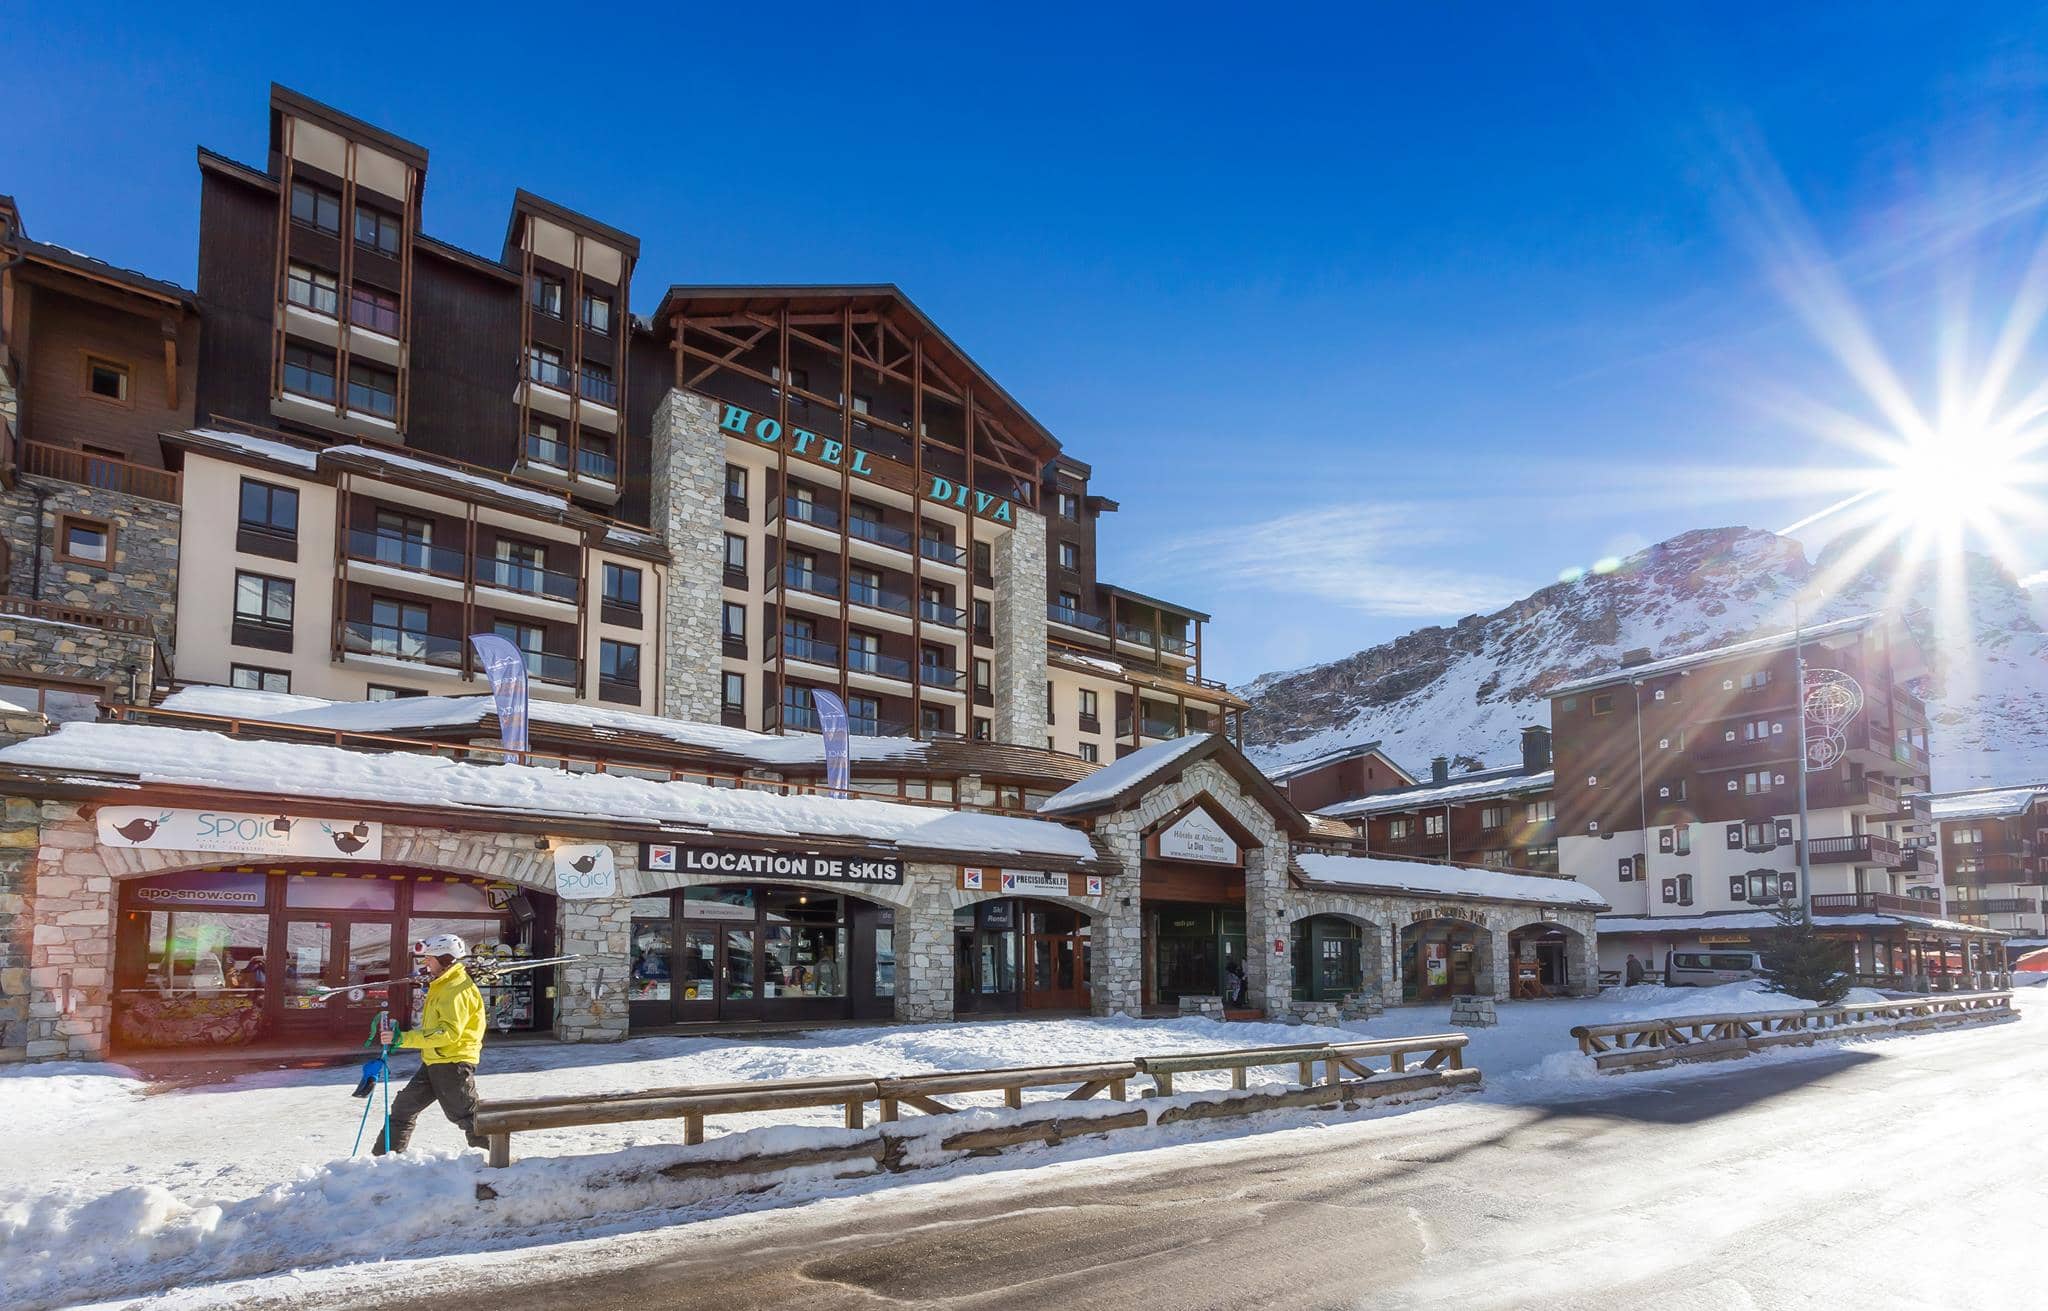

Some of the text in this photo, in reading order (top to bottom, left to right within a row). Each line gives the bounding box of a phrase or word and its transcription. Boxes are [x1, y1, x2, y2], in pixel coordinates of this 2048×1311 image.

[719, 403, 1012, 522] HOTEL DIVA
[687, 851, 897, 880] LOCATION DE SKIS
[138, 888, 257, 902] apo-snow.com
